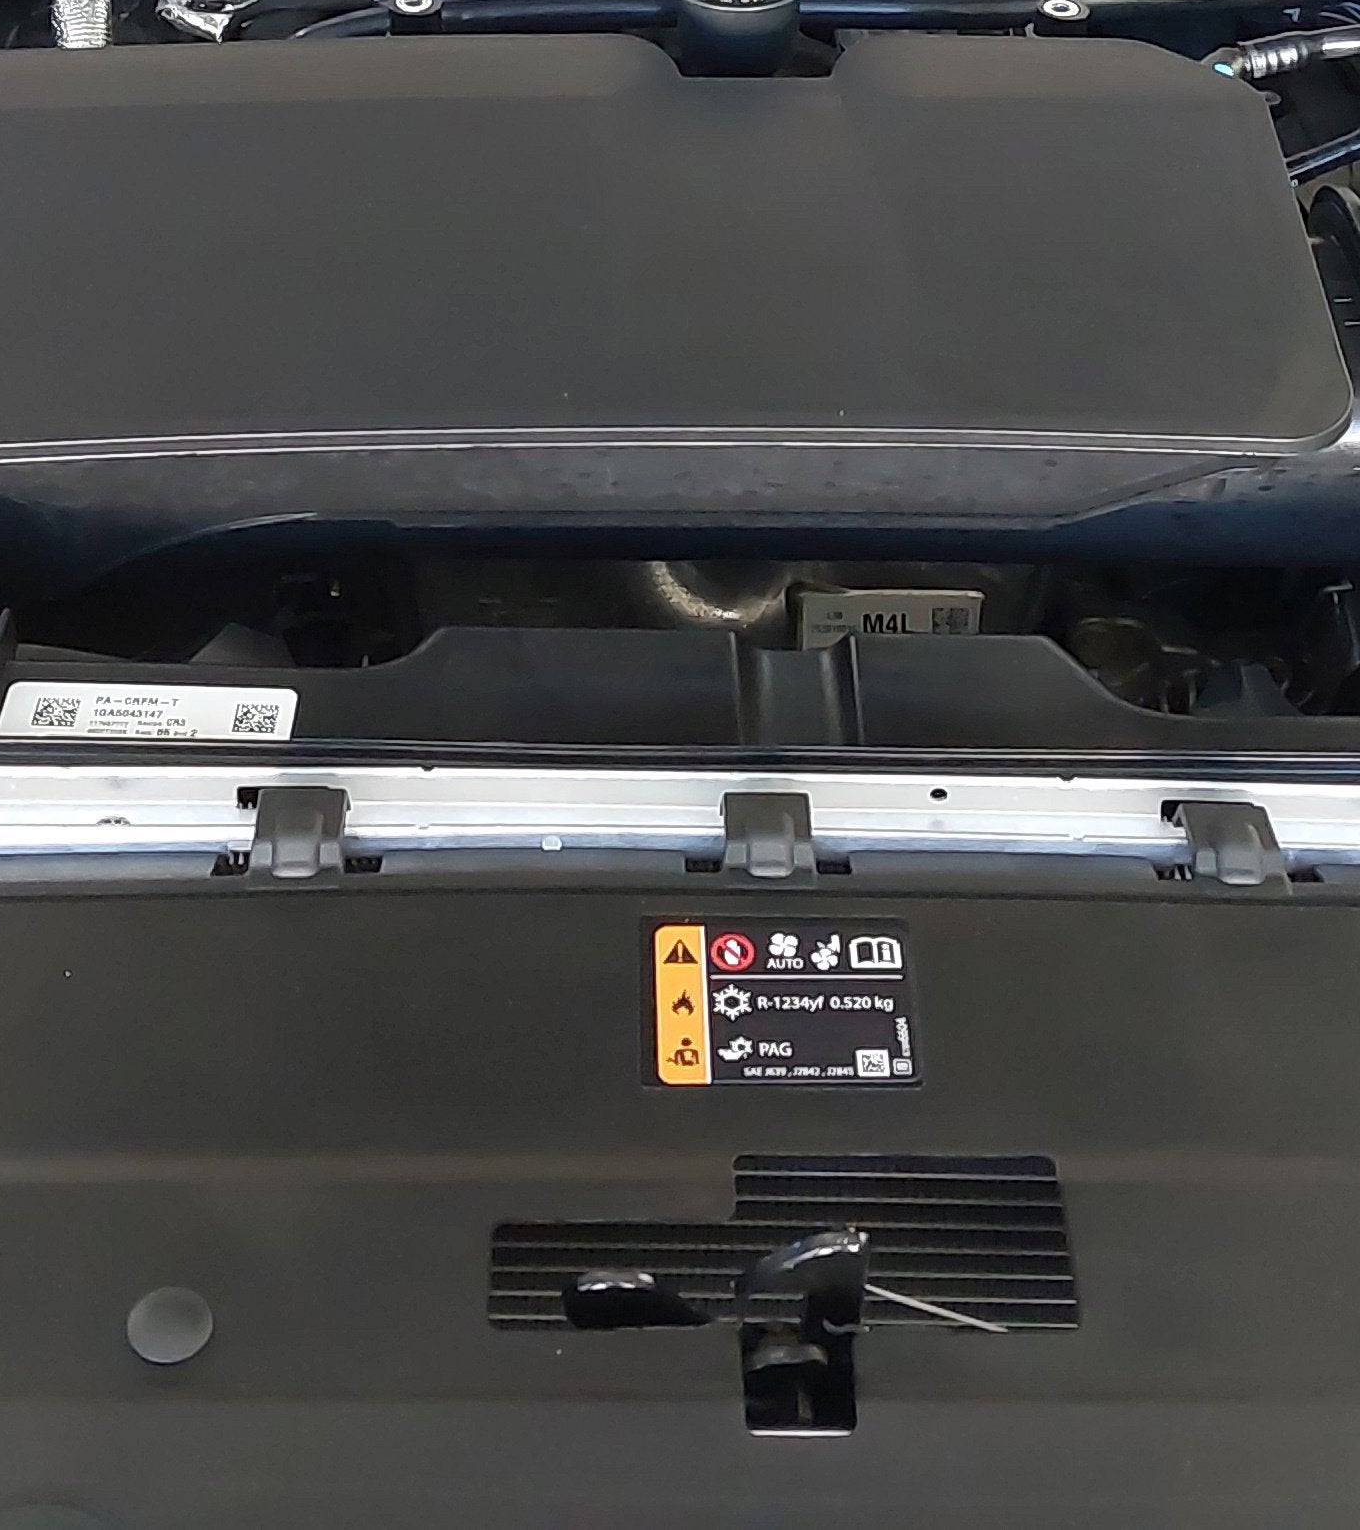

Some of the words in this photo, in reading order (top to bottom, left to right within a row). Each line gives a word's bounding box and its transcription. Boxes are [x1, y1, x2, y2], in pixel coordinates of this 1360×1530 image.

[862, 613, 911, 634] M4L
[766, 958, 804, 969] AUTO
[757, 995, 824, 1012] R-1234yf
[830, 995, 871, 1009] 0.520
[874, 995, 894, 1012] kg
[759, 1041, 792, 1057] PAG
